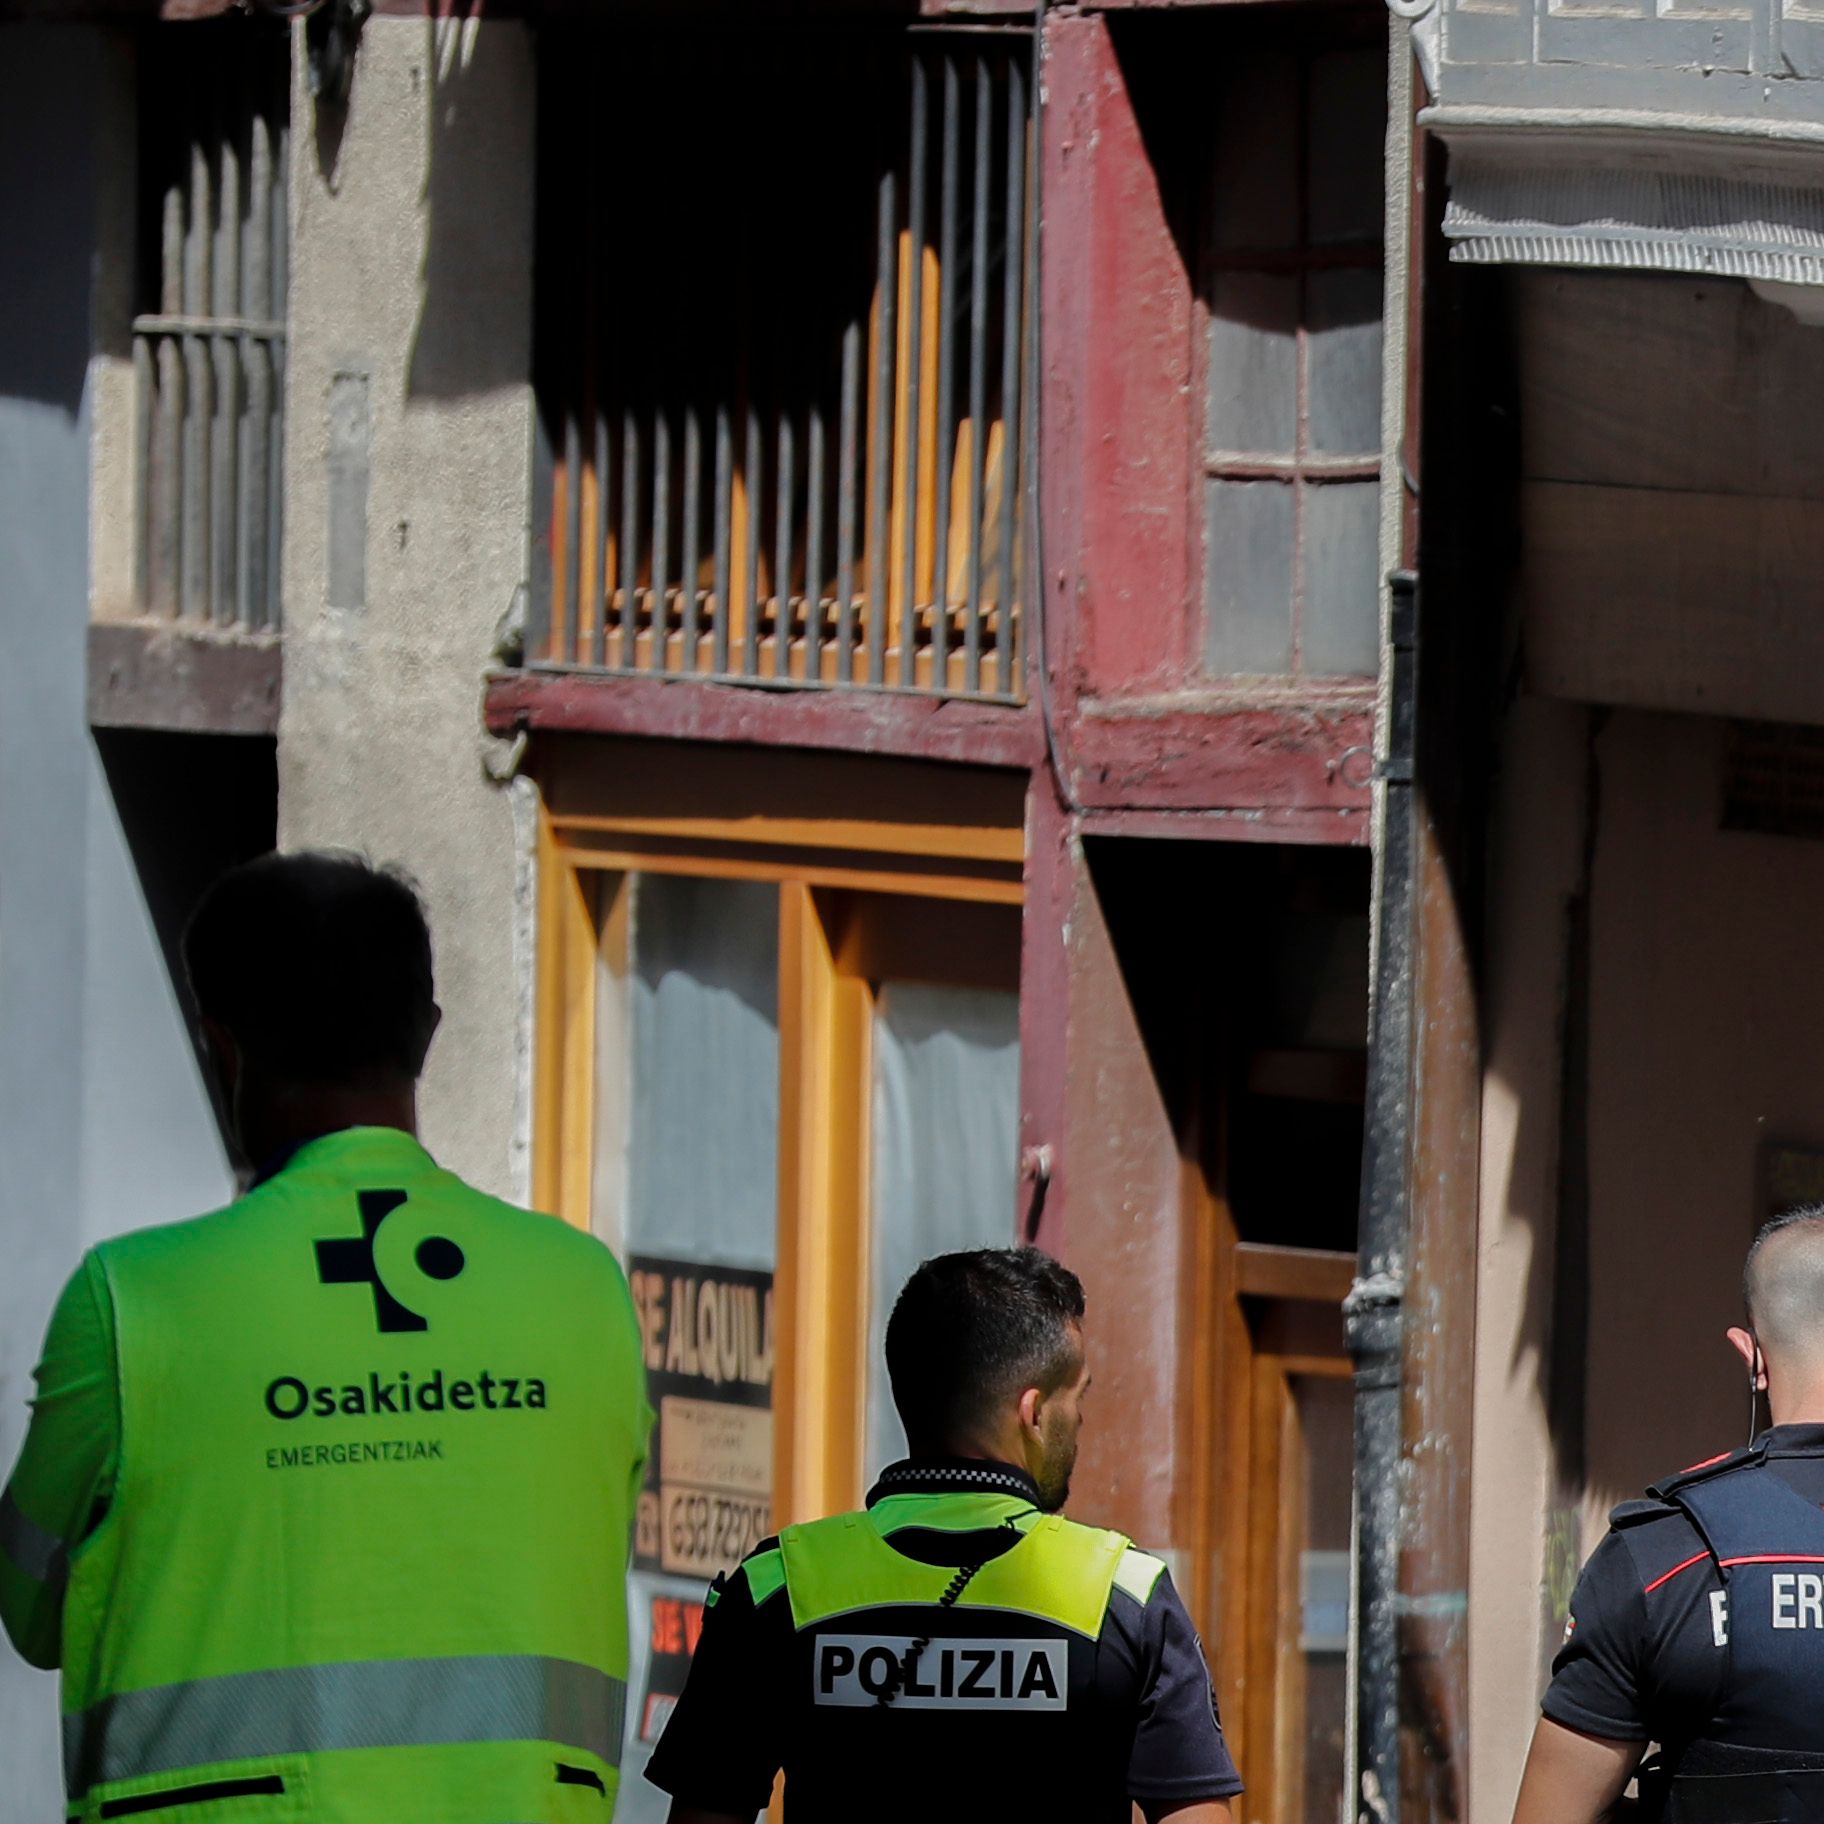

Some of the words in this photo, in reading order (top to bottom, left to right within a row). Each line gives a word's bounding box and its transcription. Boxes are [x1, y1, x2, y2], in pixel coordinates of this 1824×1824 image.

[266, 1371, 546, 1420] Osakidetza
[266, 1440, 444, 1469] EMERGENTZIAK
[819, 1645, 1059, 1700] POLIZIA
